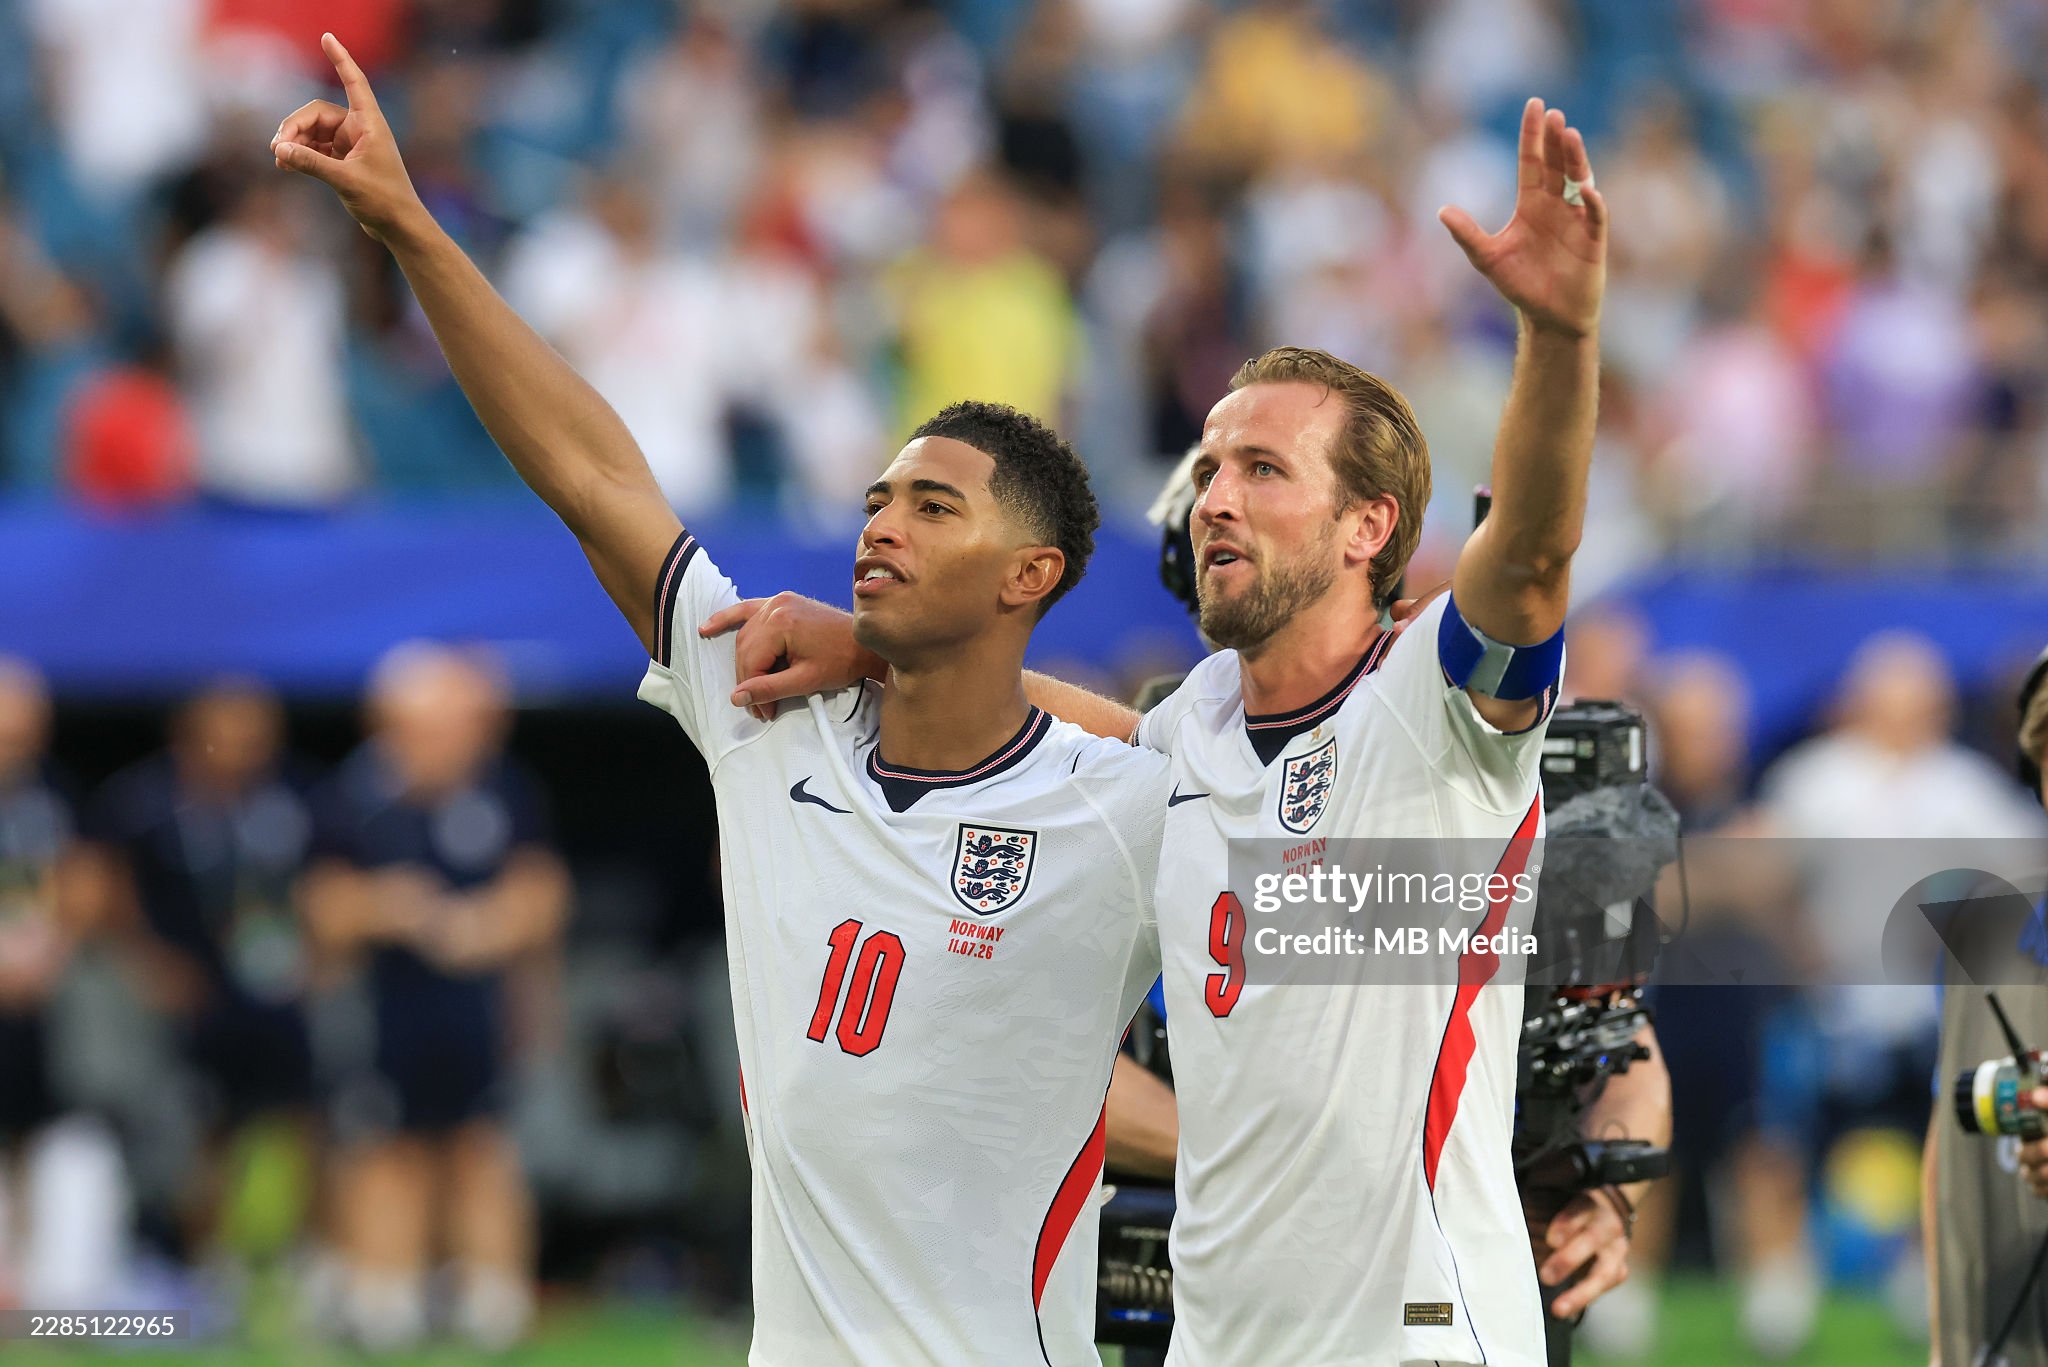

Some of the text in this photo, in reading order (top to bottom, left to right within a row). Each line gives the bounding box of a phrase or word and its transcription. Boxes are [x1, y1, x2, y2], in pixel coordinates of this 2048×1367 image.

[1282, 836, 1327, 864] NORWAY
[949, 919, 1005, 942] NORWAY
[948, 938, 994, 960] 11.07.26
[1205, 891, 1247, 1018] 9
[807, 918, 906, 1058] 10
